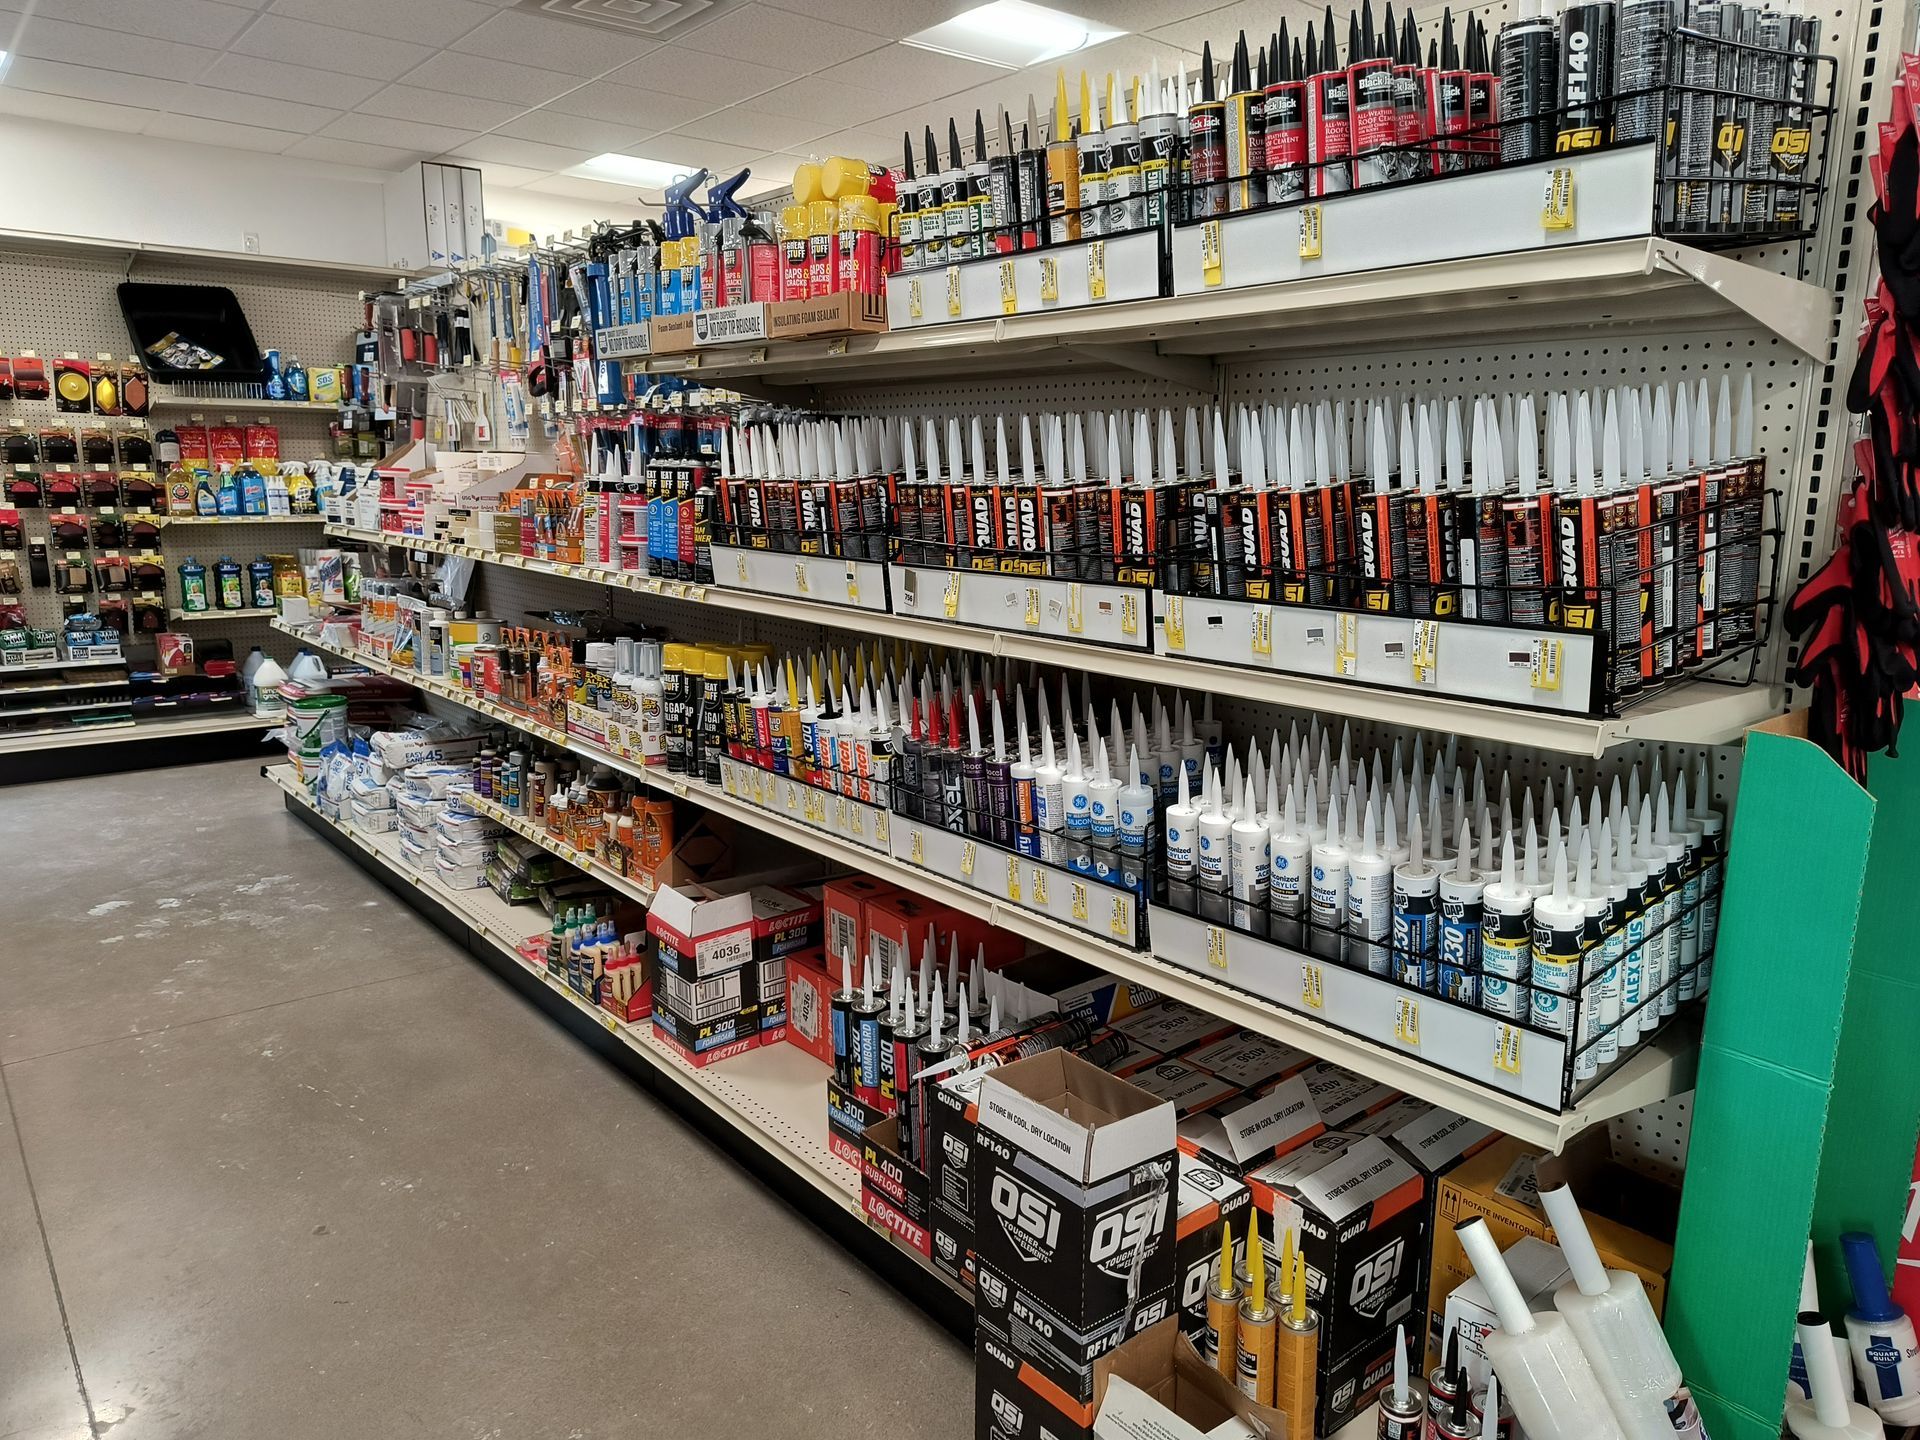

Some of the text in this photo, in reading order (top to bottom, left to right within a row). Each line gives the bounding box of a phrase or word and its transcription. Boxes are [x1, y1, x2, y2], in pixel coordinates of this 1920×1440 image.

[1359, 78, 1382, 90] Black
[1566, 31, 1589, 118] RF140
[1278, 98, 1296, 110] Jack
[1443, 86, 1460, 96] Jack
[1203, 116, 1220, 128] Jack
[1358, 110, 1392, 119] ALL-WEATHER
[1358, 117, 1376, 126] ROOF
[1157, 137, 1174, 152] DAP
[1272, 136, 1300, 146] CEMENT
[1771, 129, 1810, 154] OSI
[919, 191, 931, 203] DAP
[943, 184, 956, 196] DAP
[786, 240, 805, 251] GREAT
[787, 249, 806, 260] STUFF
[810, 243, 828, 254] STUFF
[784, 268, 810, 280] GAPS &
[786, 278, 808, 287] CRACKS
[658, 322, 683, 332] Foam Sealant
[710, 316, 760, 337] NO DRIP TIP REUSABLE
[774, 308, 840, 328] INSULATING FOAM SEALANT
[628, 334, 648, 350] REUSABLE
[317, 374, 334, 384] SOS
[748, 488, 762, 528] QUAD
[802, 490, 816, 530] QUAD
[1193, 493, 1208, 550] QUAD
[975, 497, 990, 548] QUAD
[1005, 496, 1018, 548] QUAD
[1020, 498, 1036, 551] QUAD
[1130, 502, 1142, 562] QUAD
[1242, 508, 1256, 572] QUAD
[1279, 508, 1291, 574] QUAD
[1362, 512, 1376, 578] QUAD
[1444, 508, 1456, 578] QUAD
[1562, 517, 1578, 594] QUAD
[904, 592, 913, 602] 756
[670, 702, 685, 714] GAP
[803, 724, 812, 752] 300
[426, 750, 443, 761] 45
[856, 742, 870, 802] Stretch
[1068, 818, 1092, 827] SILICON
[768, 912, 810, 932] LOCTITE
[774, 926, 808, 943] PL 300
[656, 925, 680, 947] LOCTITE
[658, 940, 678, 959] PL 300
[1444, 927, 1464, 966] 230
[712, 944, 740, 961] 4036
[1534, 960, 1562, 972] SILICONIZED
[1626, 966, 1642, 1004] ALEX
[657, 1006, 676, 1026] PL 300
[766, 1002, 780, 1016] PL
[802, 992, 811, 1022] 4036
[700, 1018, 736, 1039] PL 300
[702, 1030, 736, 1048] FOAMBOARD
[663, 1032, 688, 1056] LOCTITE
[706, 1040, 750, 1064] LOCTITE
[852, 1027, 862, 1088] PL 300
[862, 1024, 874, 1084] FOAMBOARD
[880, 1039, 894, 1100] PL 300
[830, 1091, 865, 1122] PL 300
[938, 1092, 962, 1112] QUAD
[988, 1100, 1072, 1155] STORE IN COOL, DRY LOCATION
[1240, 1102, 1306, 1139] STORE IN COOL, DRY LOCATION
[976, 1132, 1010, 1160] RF140
[1418, 1120, 1460, 1150] STORE COOL, DRY
[942, 1135, 969, 1164] OSI
[864, 1146, 904, 1184] PL 400
[1324, 1157, 1394, 1200] STORE IN COOL, DRY LOCATION
[864, 1164, 903, 1198] SUBFLOOR
[990, 1174, 1062, 1250] OSI
[1222, 1192, 1250, 1215] QUAD
[1462, 1198, 1536, 1236] ROTATE INVENTORY
[868, 1196, 923, 1246] LOCTITE
[1004, 1220, 1040, 1248] TOUGHER
[1089, 1192, 1170, 1264] OSI
[1340, 1219, 1366, 1243] QUAD
[936, 1232, 958, 1257] OSI
[1020, 1240, 1048, 1264] ELEMENTS
[980, 1270, 1008, 1303] OSI
[1350, 1240, 1404, 1306] OSI
[1013, 1300, 1053, 1338] RF140
[1134, 1300, 1168, 1332] OSI
[984, 1342, 1015, 1369] QUAD
[1362, 1362, 1392, 1390] QUAD
[1331, 1377, 1356, 1407] OSI
[991, 1392, 1024, 1430] OSI
